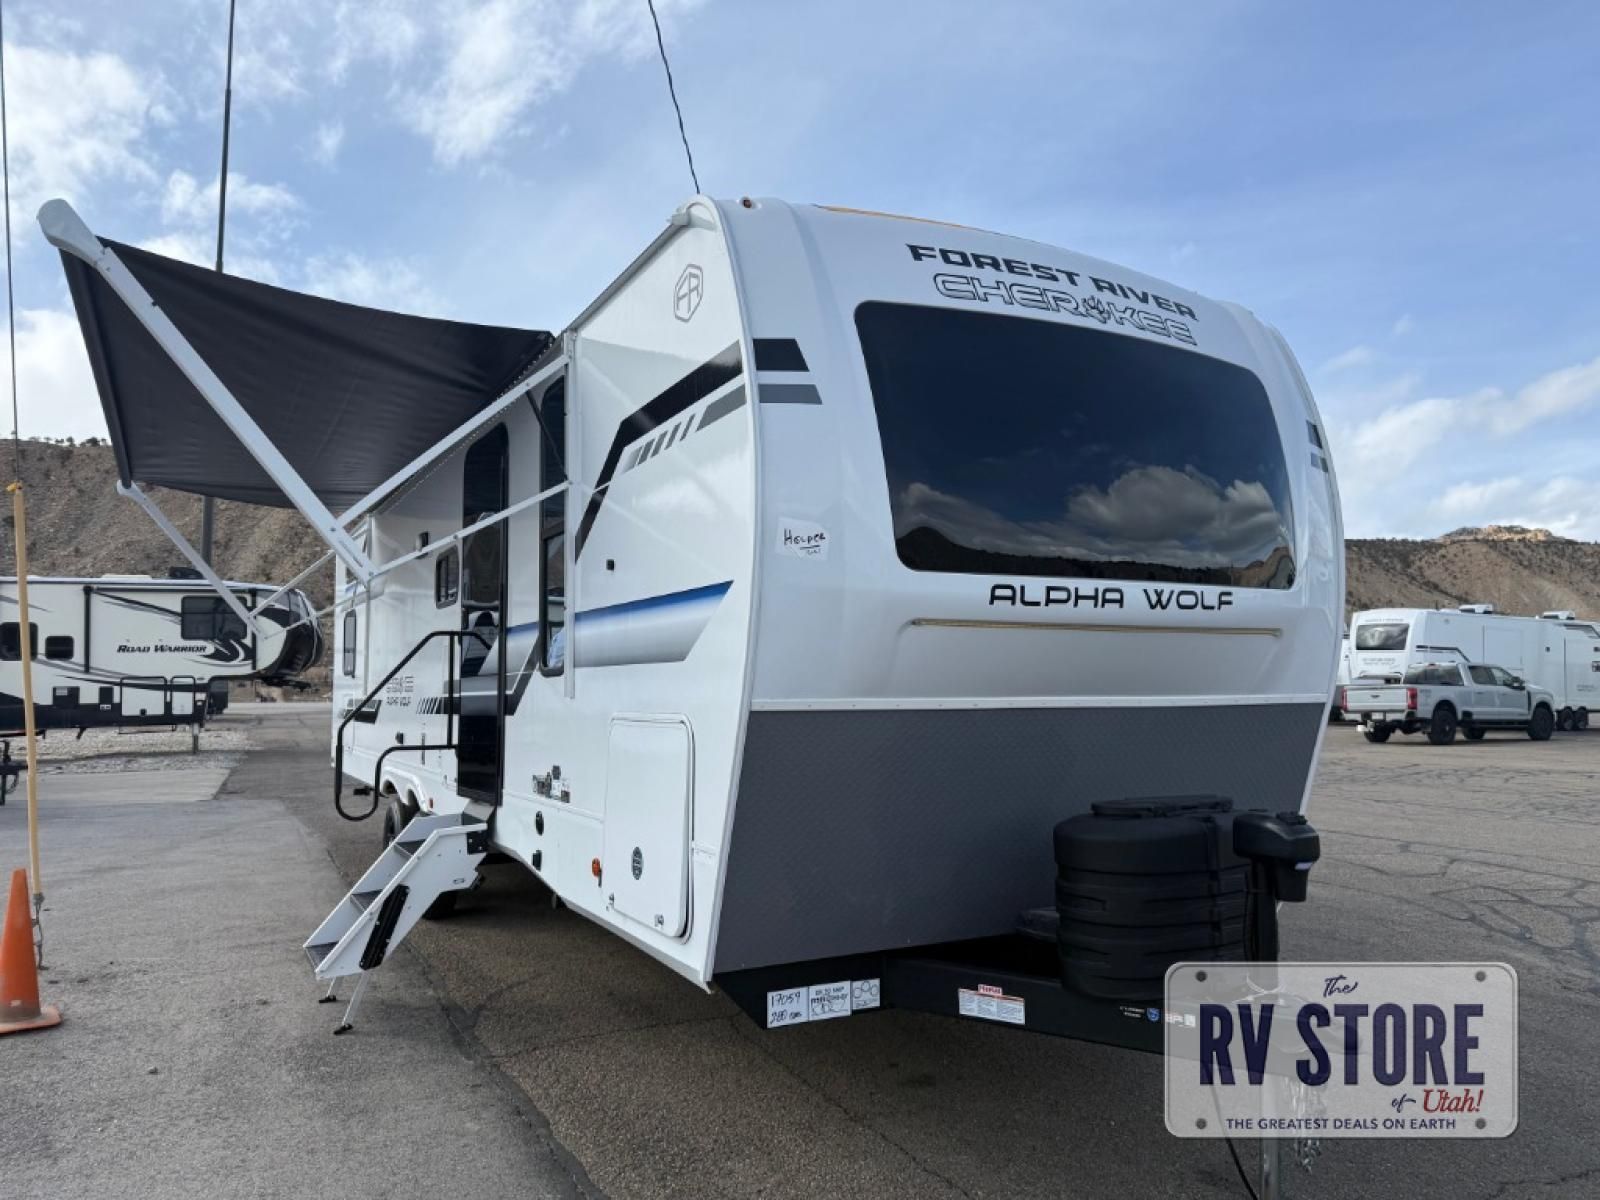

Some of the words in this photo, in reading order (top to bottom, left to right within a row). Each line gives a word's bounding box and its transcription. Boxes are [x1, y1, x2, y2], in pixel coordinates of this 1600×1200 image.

[905, 243, 1080, 287] FOREST
[1088, 275, 1199, 322] RIVER
[989, 583, 1125, 609] ALPHA
[1143, 588, 1234, 610] WOLF
